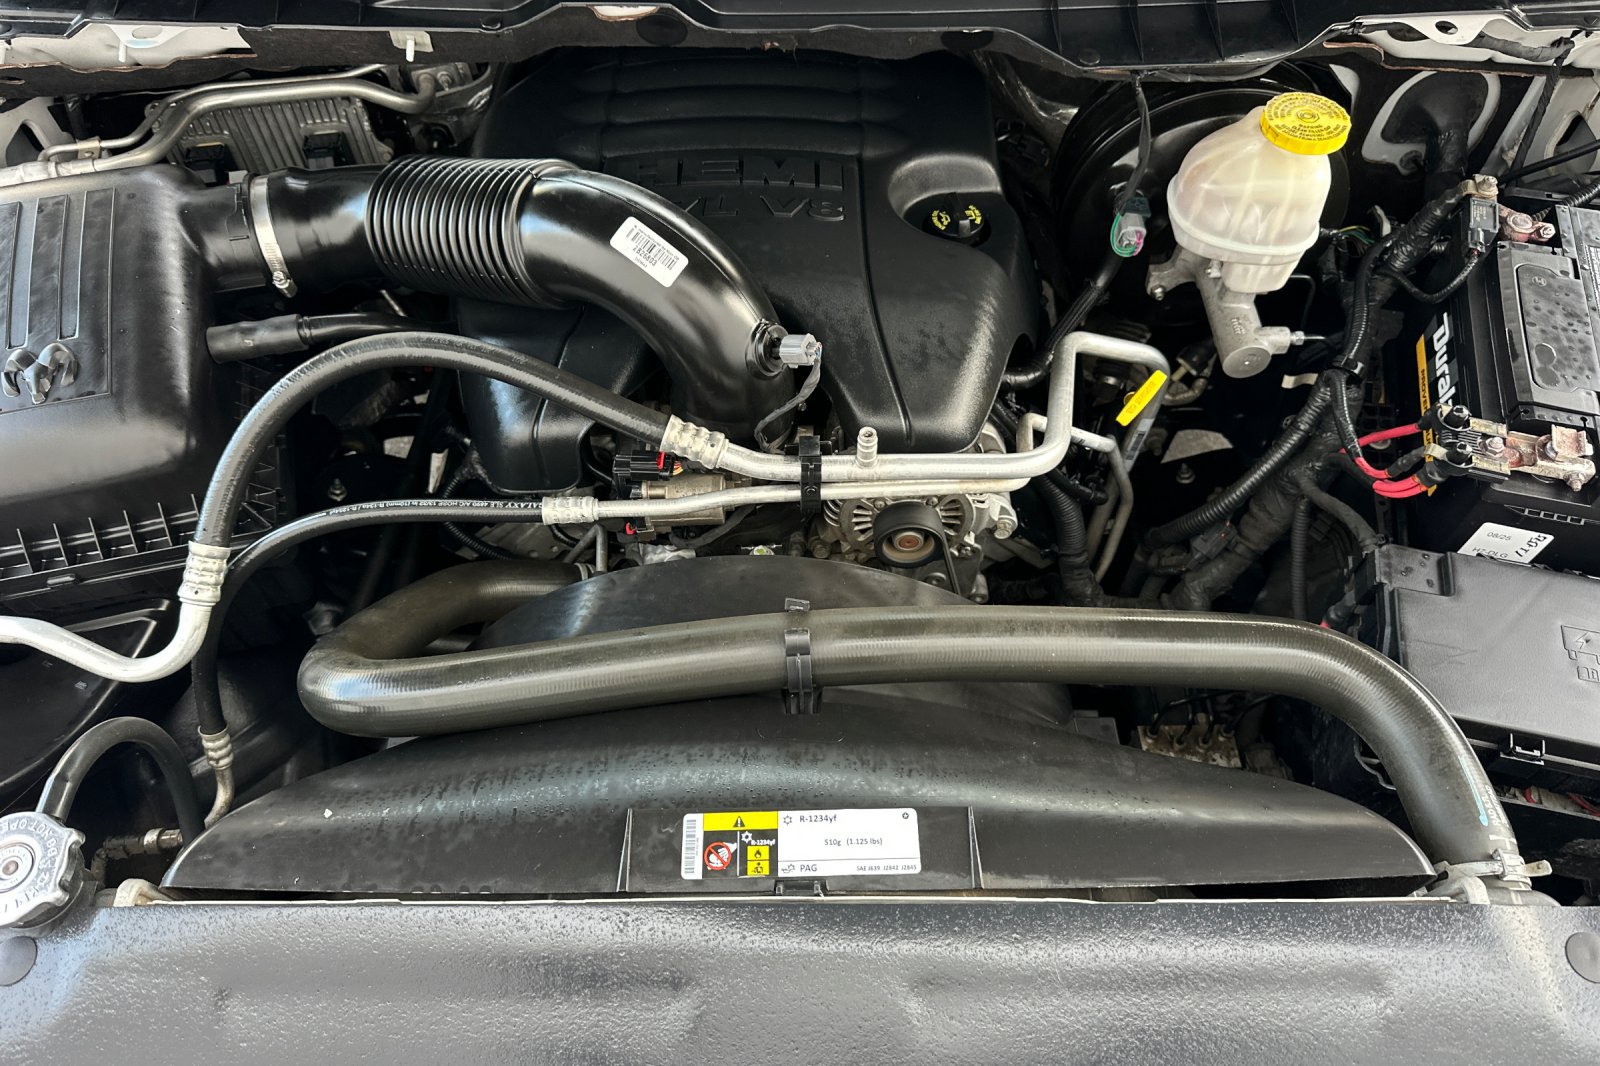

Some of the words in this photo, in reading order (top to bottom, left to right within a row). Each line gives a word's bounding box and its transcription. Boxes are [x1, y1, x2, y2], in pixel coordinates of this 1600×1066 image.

[759, 193, 846, 222] V8
[504, 501, 543, 509] GALAXY
[1486, 531, 1512, 541] 08/25
[799, 814, 837, 824] R-1234yf
[750, 838, 776, 847] R-1234yf
[824, 838, 842, 847] 510g
[846, 838, 869, 846] (1.125
[869, 837, 883, 846] lbs)
[800, 864, 818, 872] PAG
